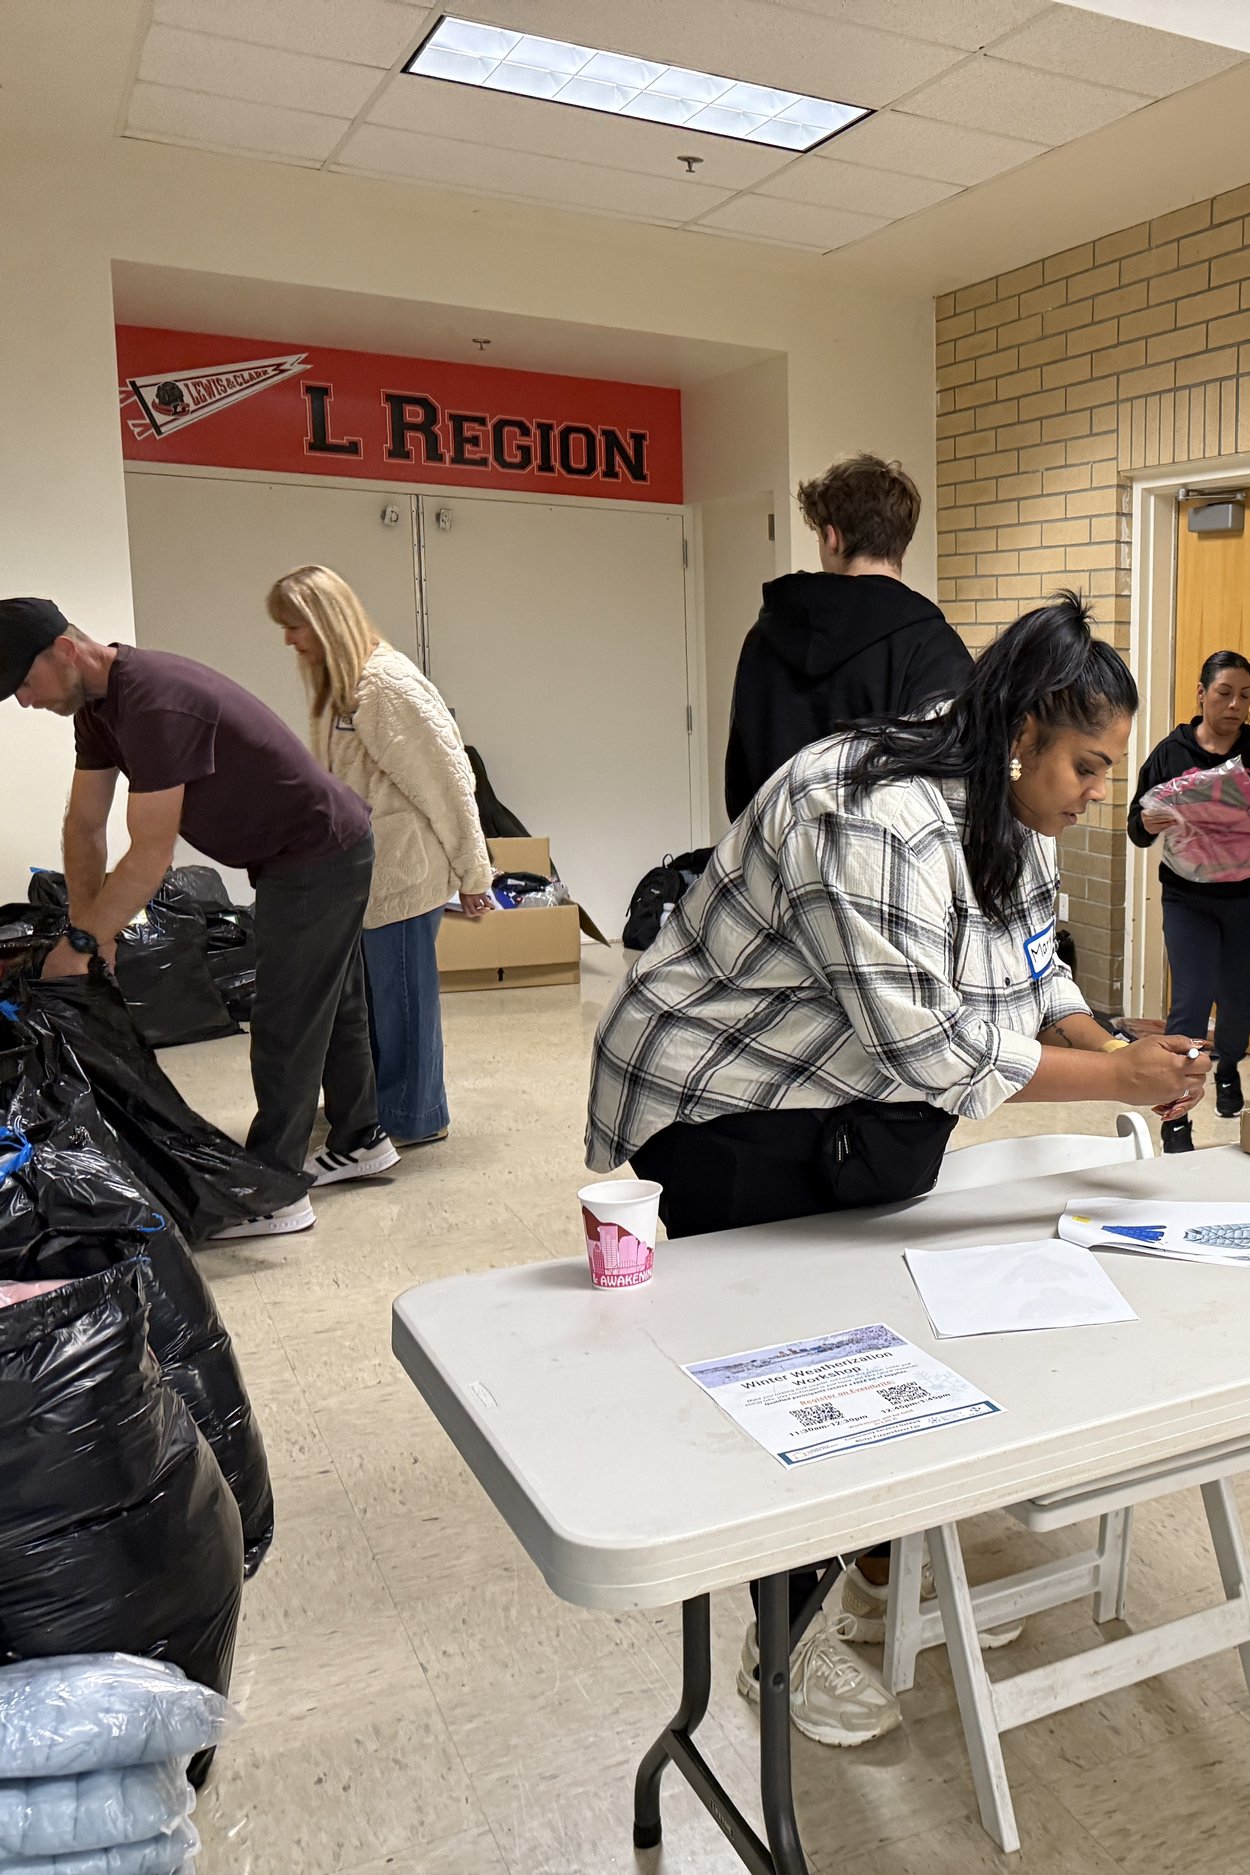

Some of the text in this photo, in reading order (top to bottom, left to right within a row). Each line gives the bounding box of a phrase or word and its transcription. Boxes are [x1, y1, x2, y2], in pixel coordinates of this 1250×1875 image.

[301, 381, 650, 485] L REGION
[740, 1375, 788, 1389] Winter
[790, 1351, 893, 1377] Weatherization
[792, 1366, 862, 1386] Workshop
